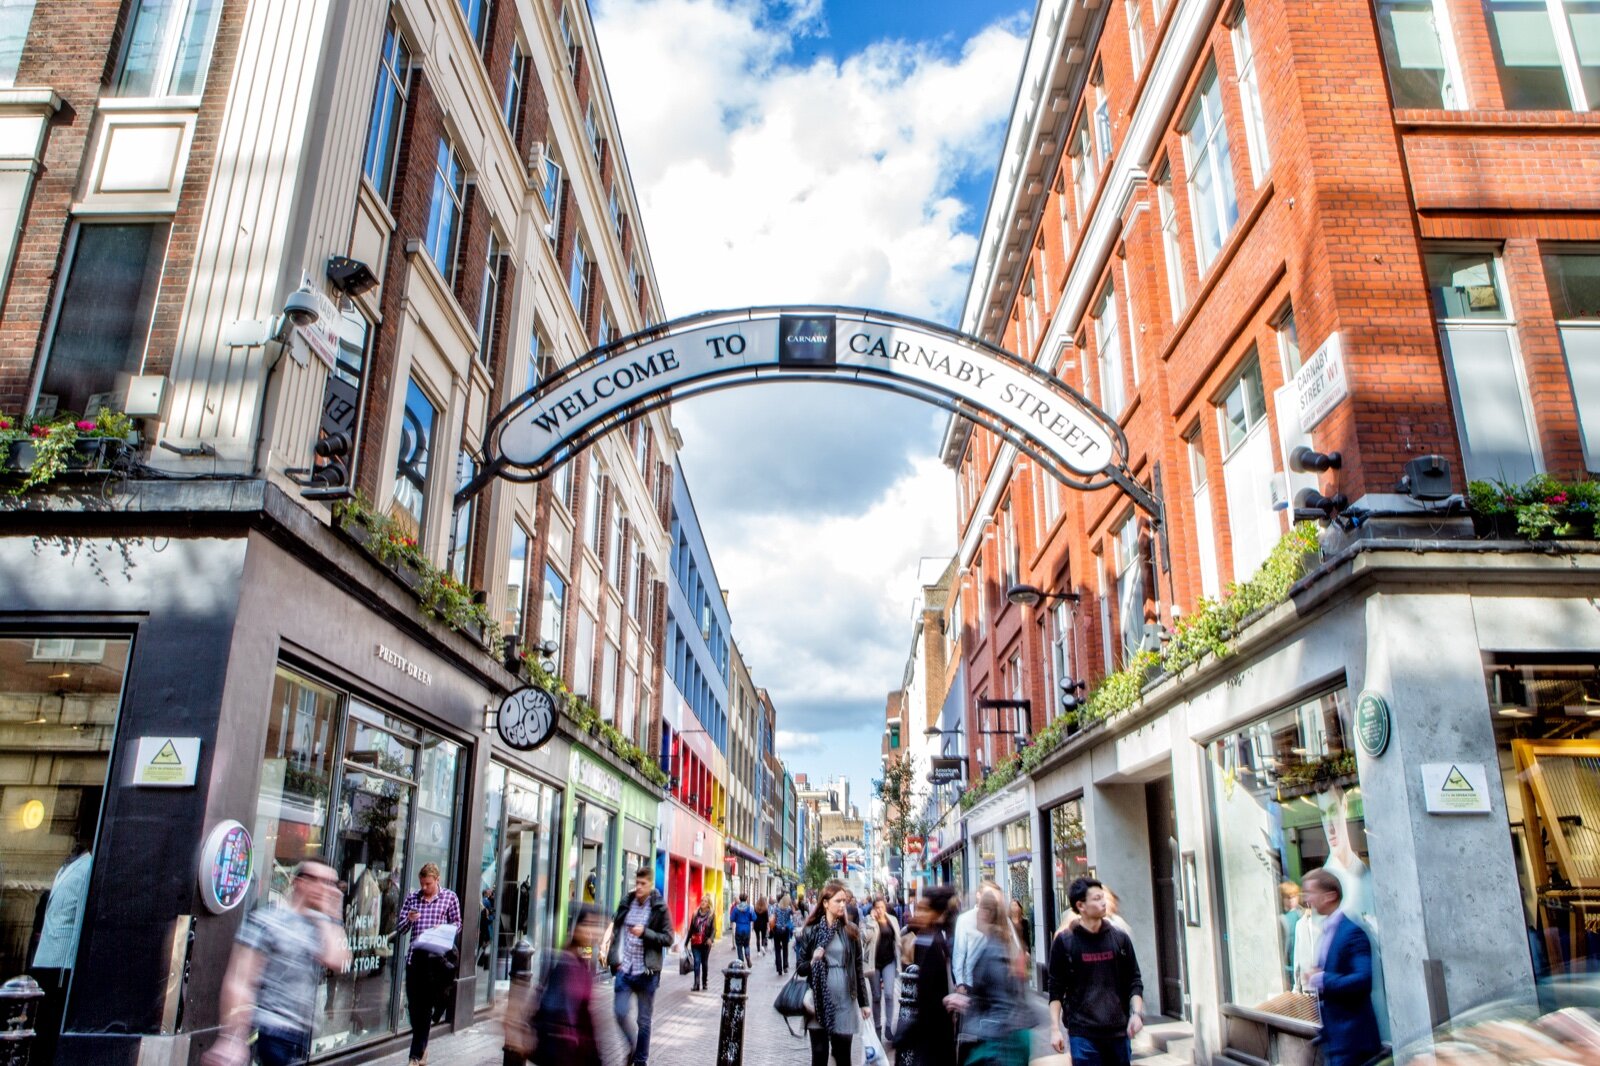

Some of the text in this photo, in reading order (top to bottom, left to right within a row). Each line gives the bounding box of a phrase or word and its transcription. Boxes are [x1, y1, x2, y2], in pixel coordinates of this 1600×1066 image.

[787, 334, 828, 344] CARNABY
[531, 334, 746, 434] WELCOME TO
[1297, 346, 1329, 392] CARNABY
[1300, 361, 1339, 411] STREET W1
[849, 332, 1100, 459] CARNABY STREET
[379, 643, 433, 687] PRETTY GREEN
[355, 914, 376, 929] NEW
[341, 955, 380, 974] IN STORE
